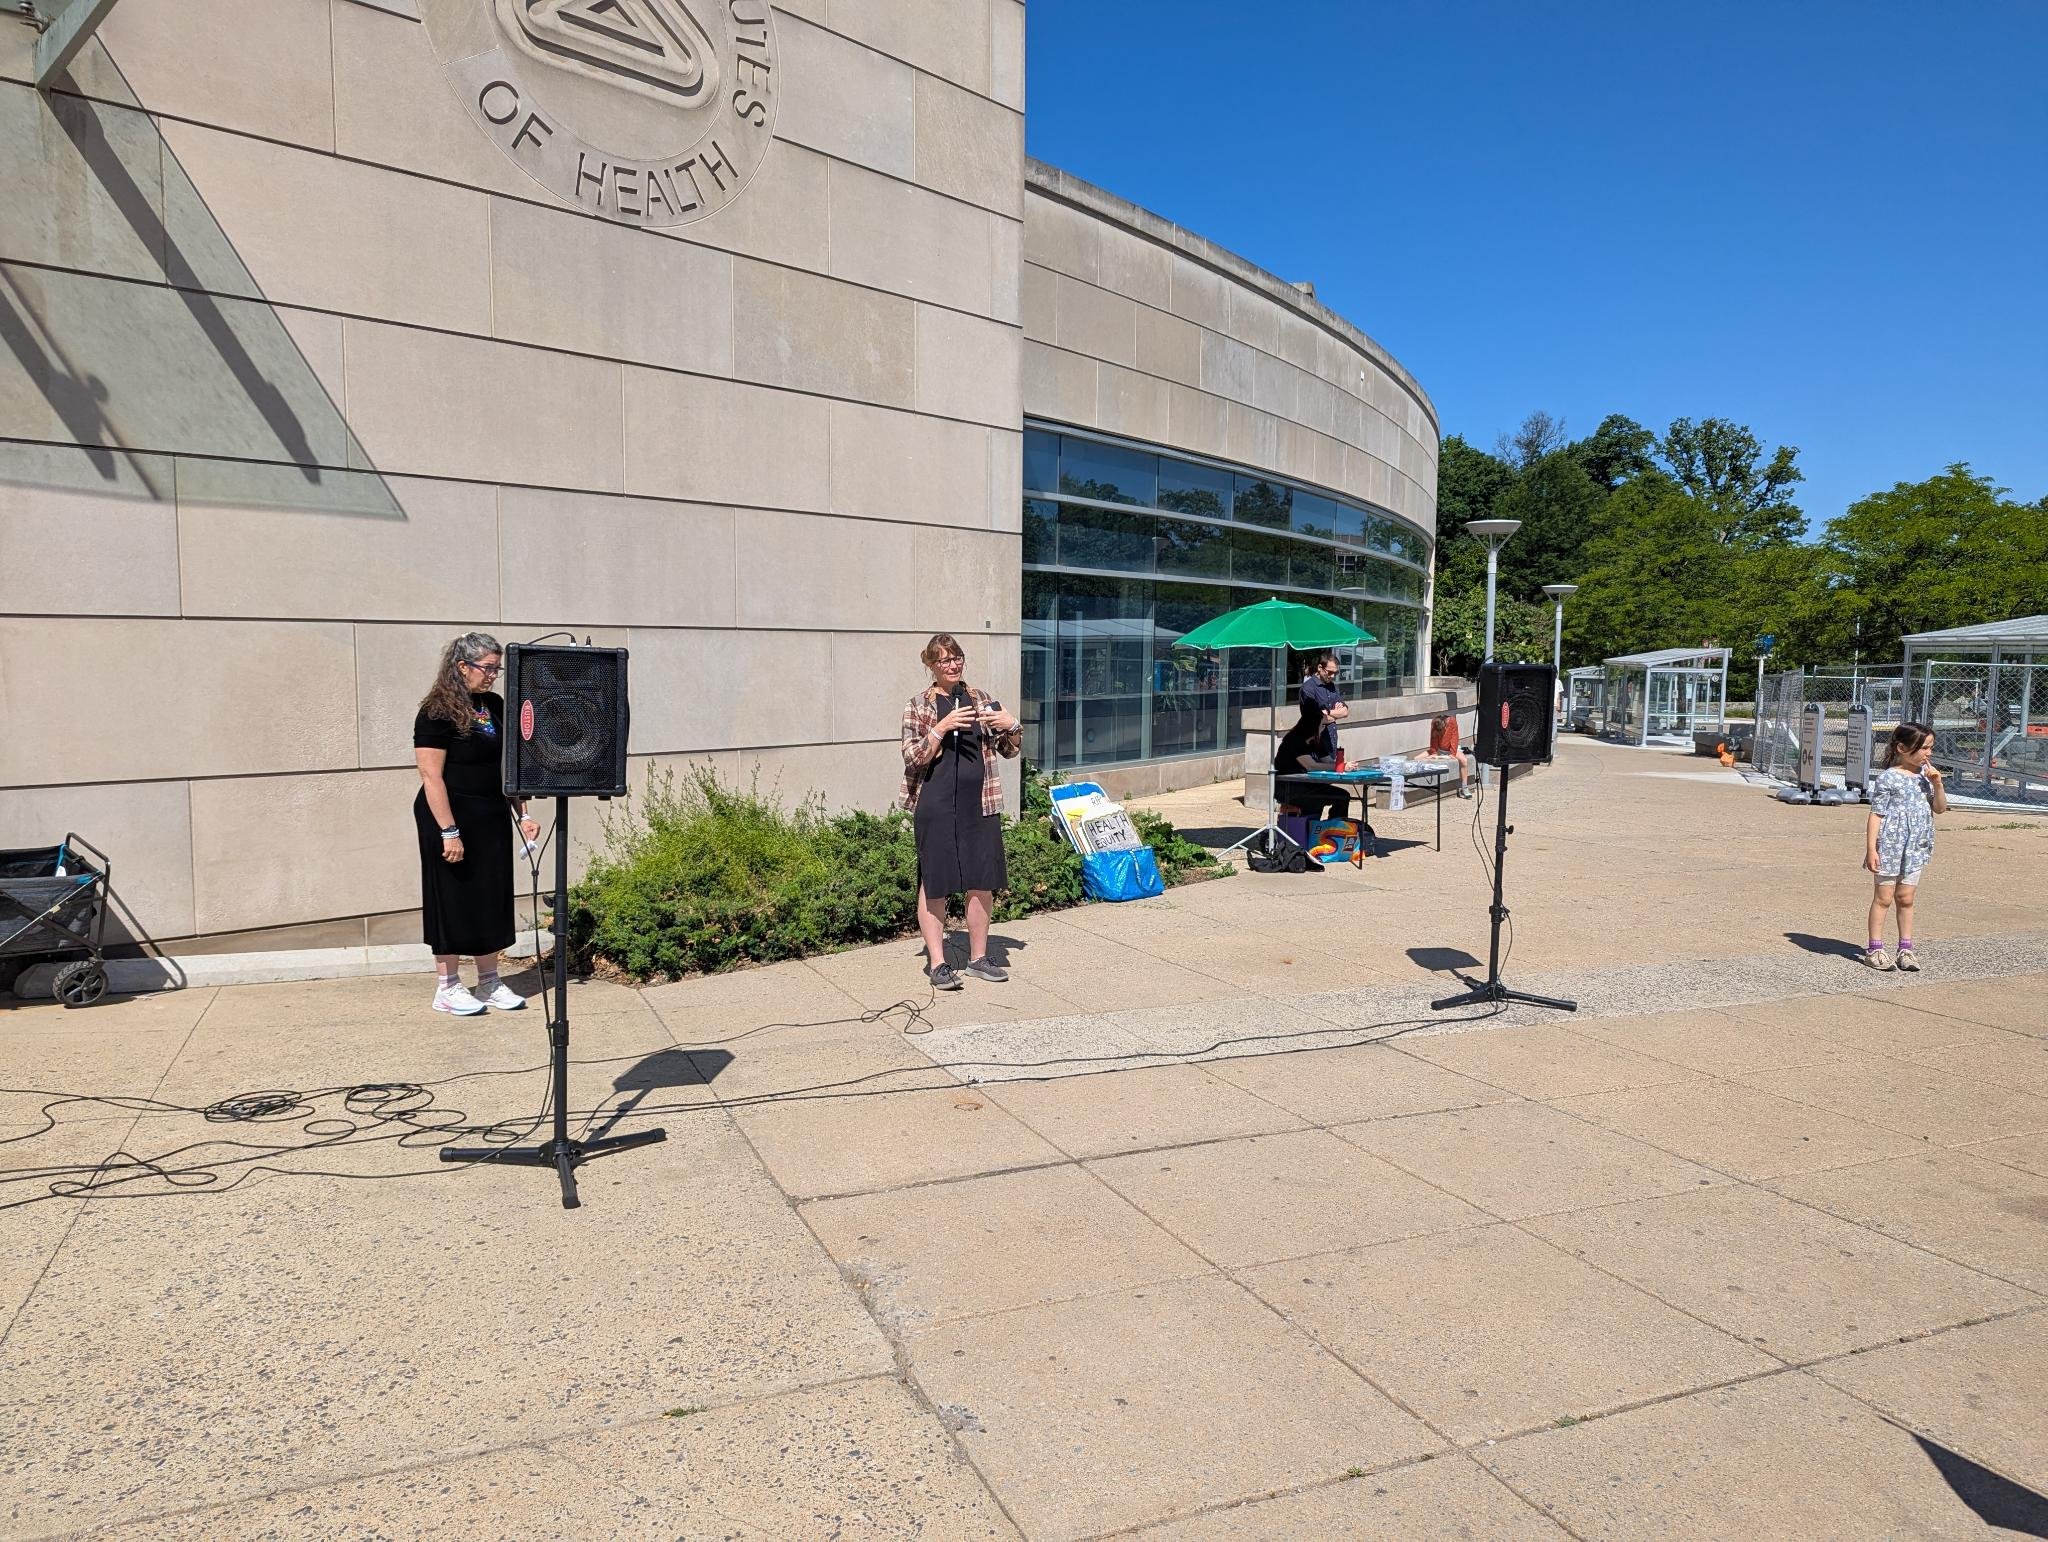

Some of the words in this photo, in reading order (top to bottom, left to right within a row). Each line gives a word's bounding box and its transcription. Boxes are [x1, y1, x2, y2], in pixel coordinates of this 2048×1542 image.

[479, 80, 553, 149] OF
[575, 140, 739, 216] HEALTH
[1088, 814, 1129, 836] HEALTH
[1095, 829, 1127, 849] EQUITY
